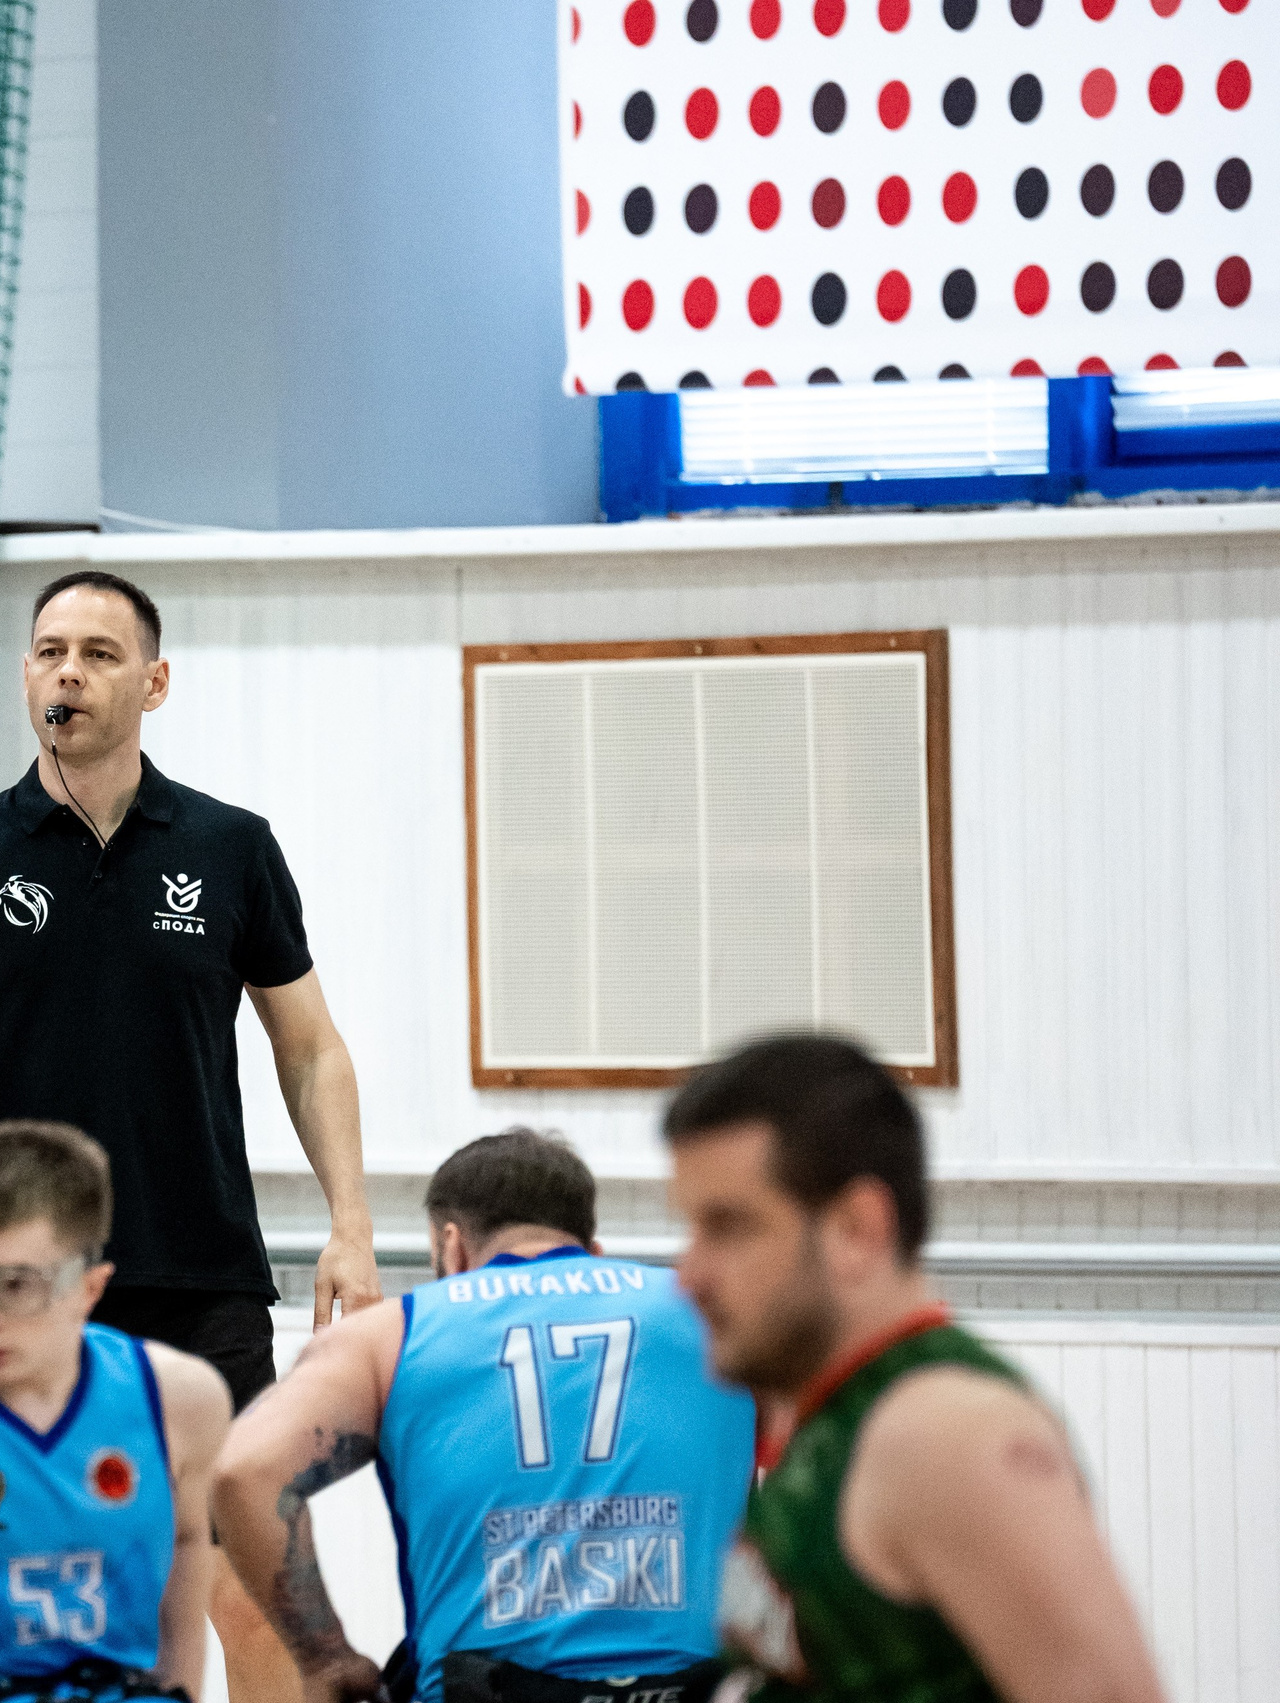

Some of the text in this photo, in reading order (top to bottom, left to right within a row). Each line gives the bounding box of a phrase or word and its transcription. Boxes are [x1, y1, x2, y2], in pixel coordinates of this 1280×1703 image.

[152, 918, 206, 936] сПОДА
[448, 1267, 645, 1303] BURAKOV
[500, 1317, 636, 1469] 17
[7, 1549, 108, 1647] 53
[486, 1535, 681, 1624] BASKI
